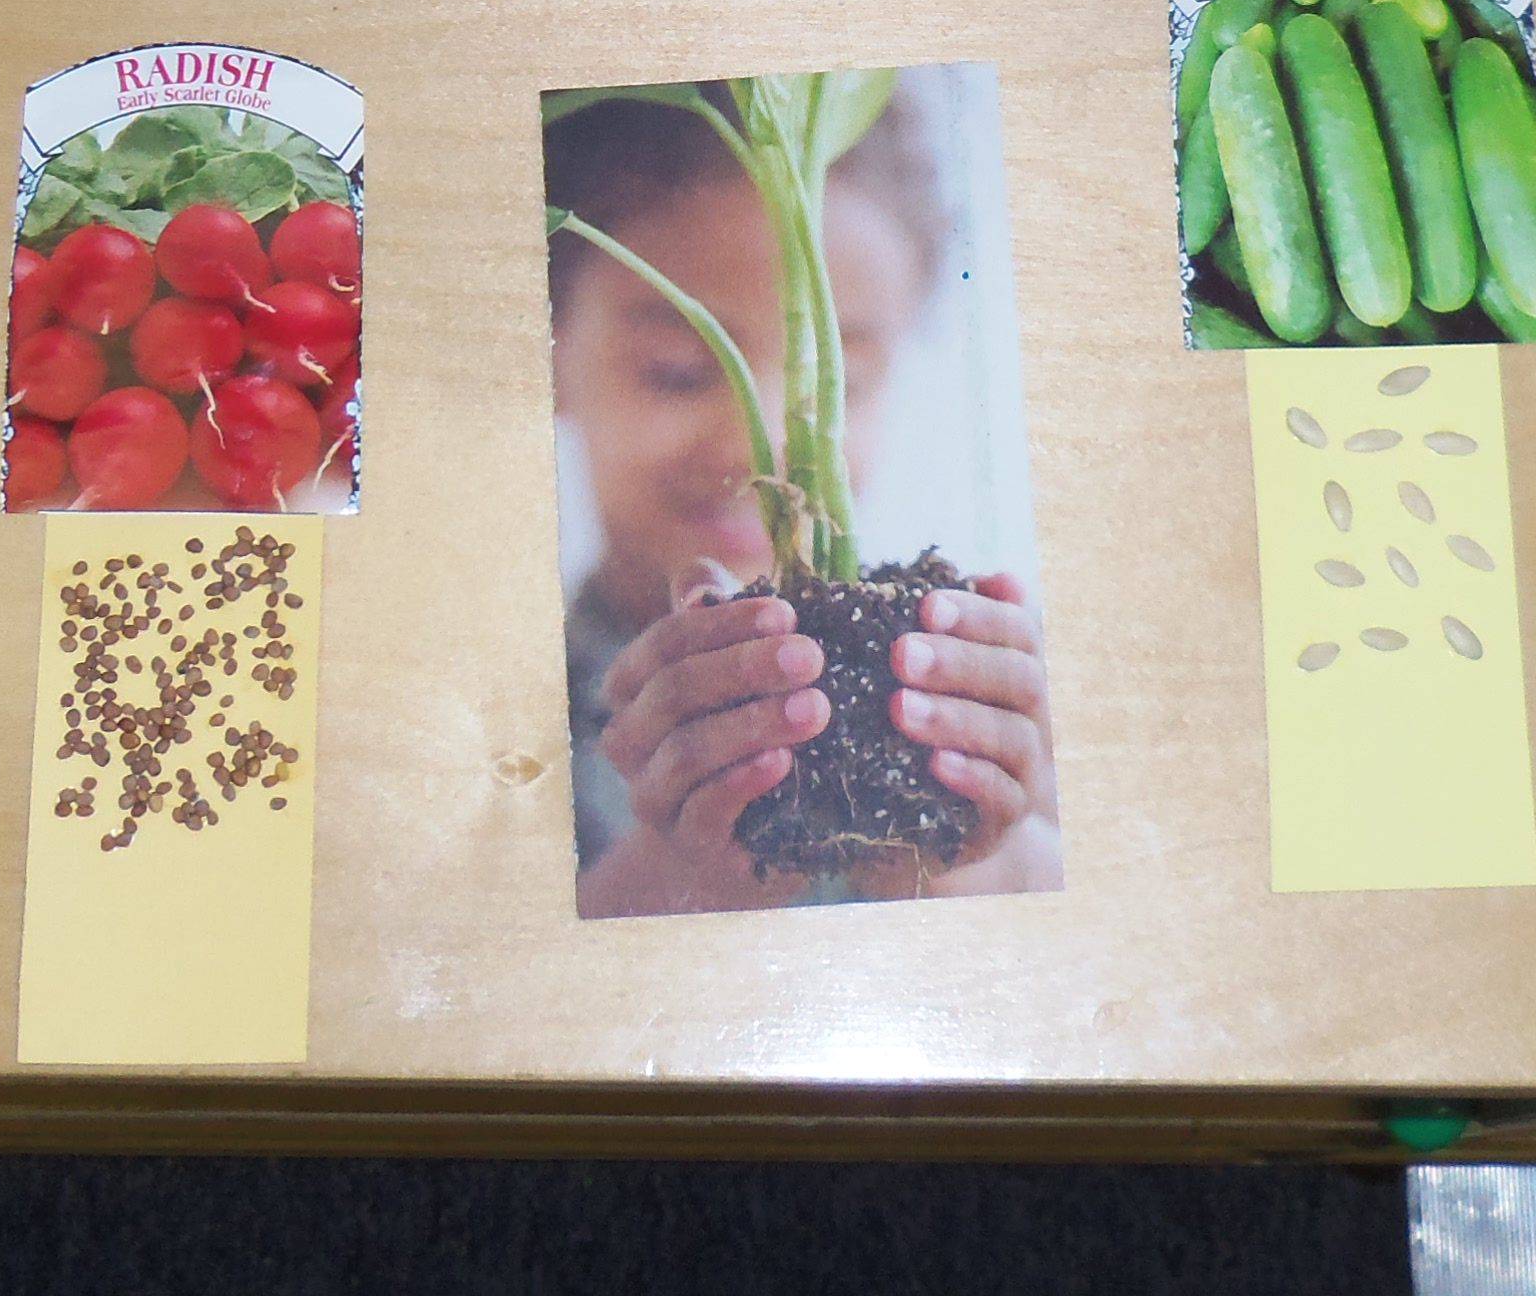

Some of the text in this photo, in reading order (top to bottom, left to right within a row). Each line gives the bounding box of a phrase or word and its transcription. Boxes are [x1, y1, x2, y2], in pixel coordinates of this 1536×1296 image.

[114, 51, 276, 94] RADISH
[117, 86, 272, 112] Early Scarlet Globe
